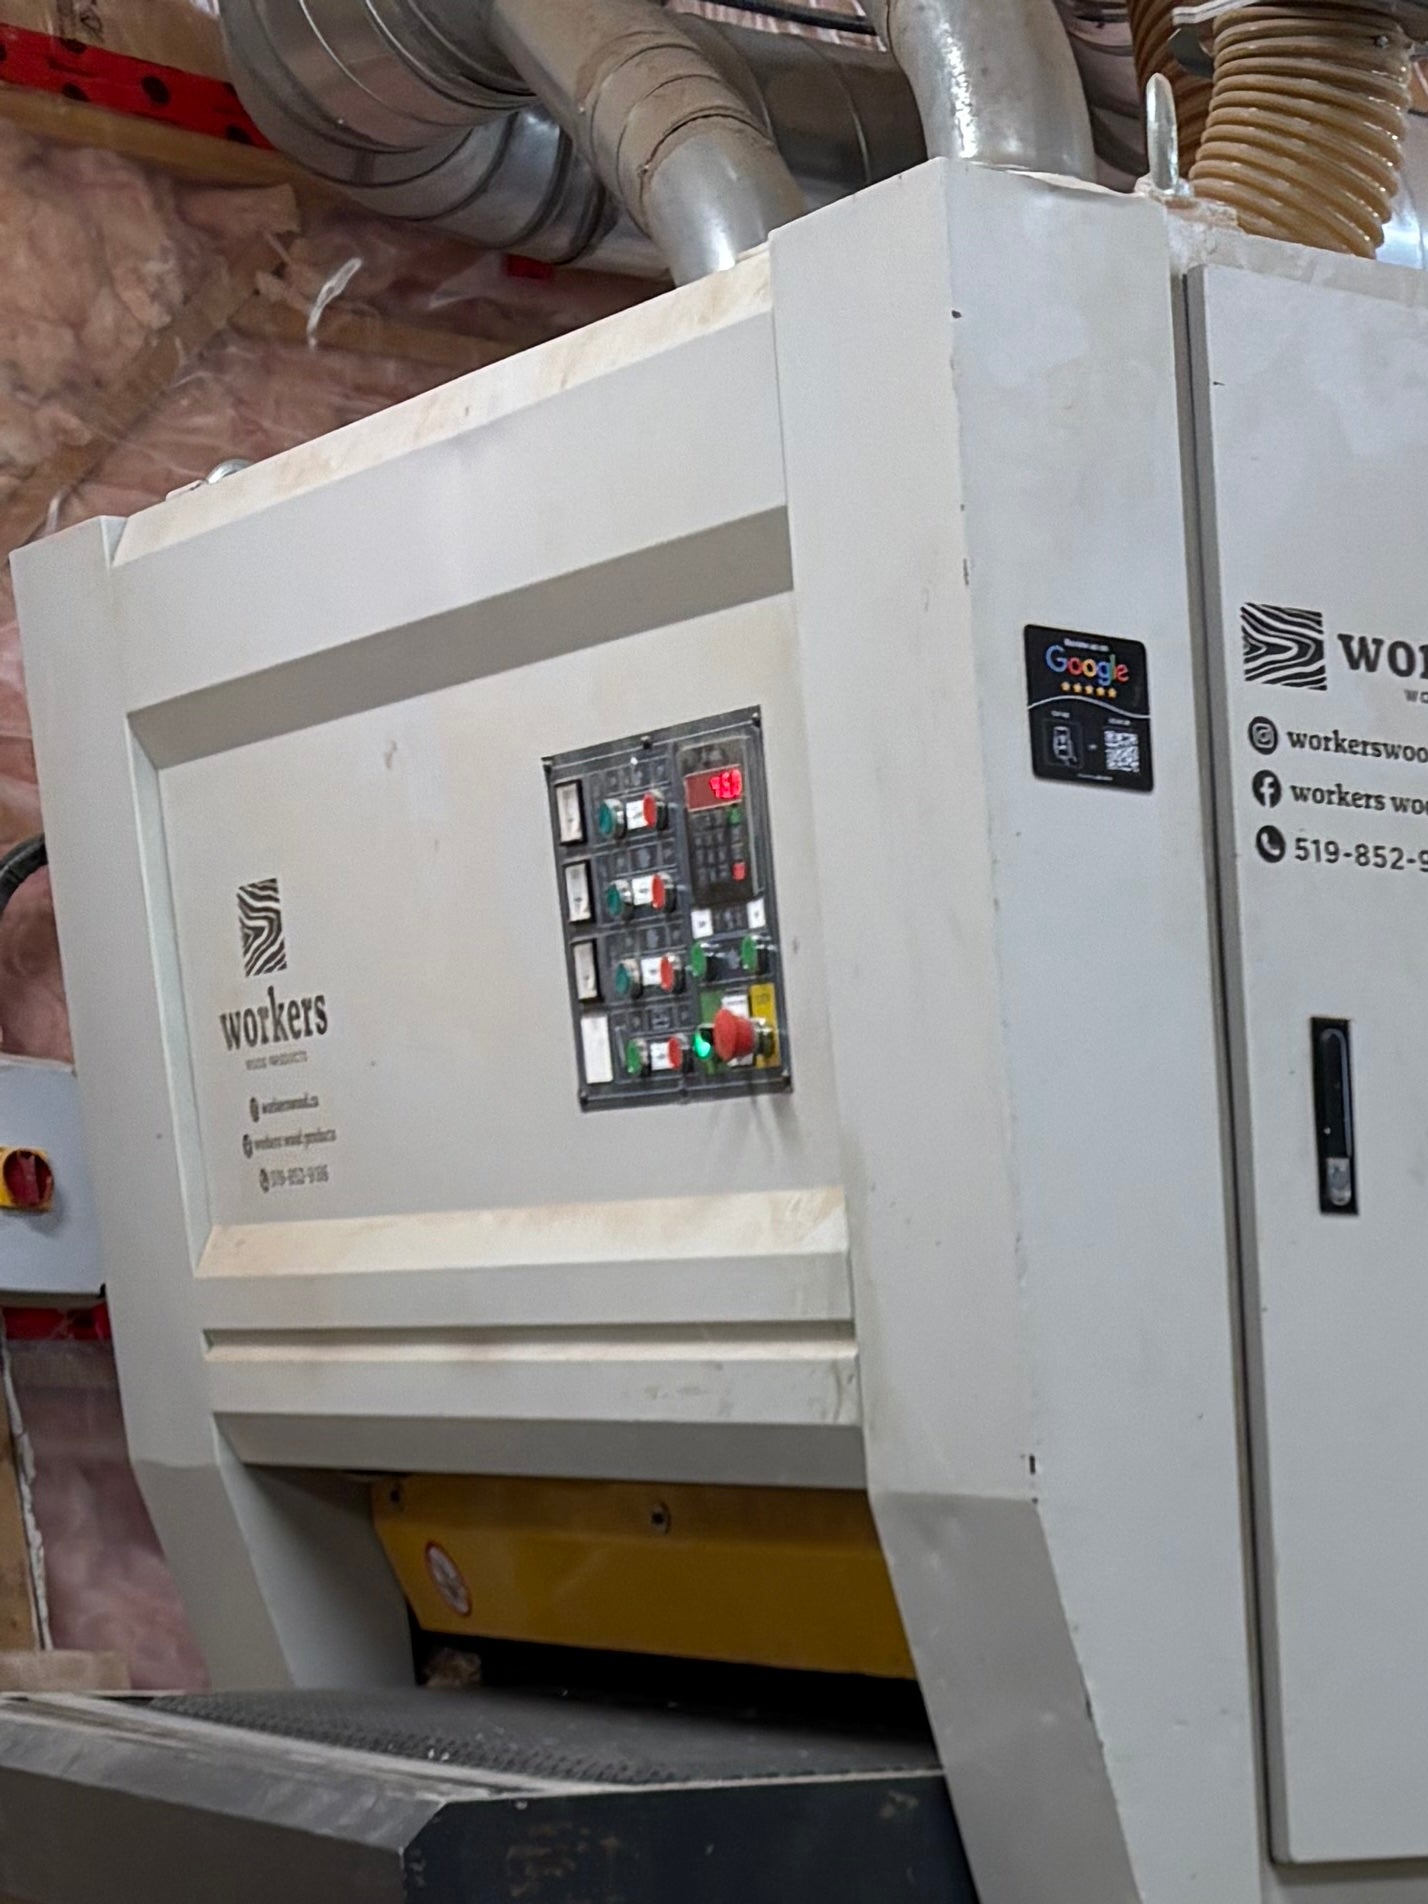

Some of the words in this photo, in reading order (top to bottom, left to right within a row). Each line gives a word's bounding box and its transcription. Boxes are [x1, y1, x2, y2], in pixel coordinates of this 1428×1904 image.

[1045, 644, 1129, 686] Google
[1290, 783, 1386, 811] workers
[219, 985, 328, 1050] workers
